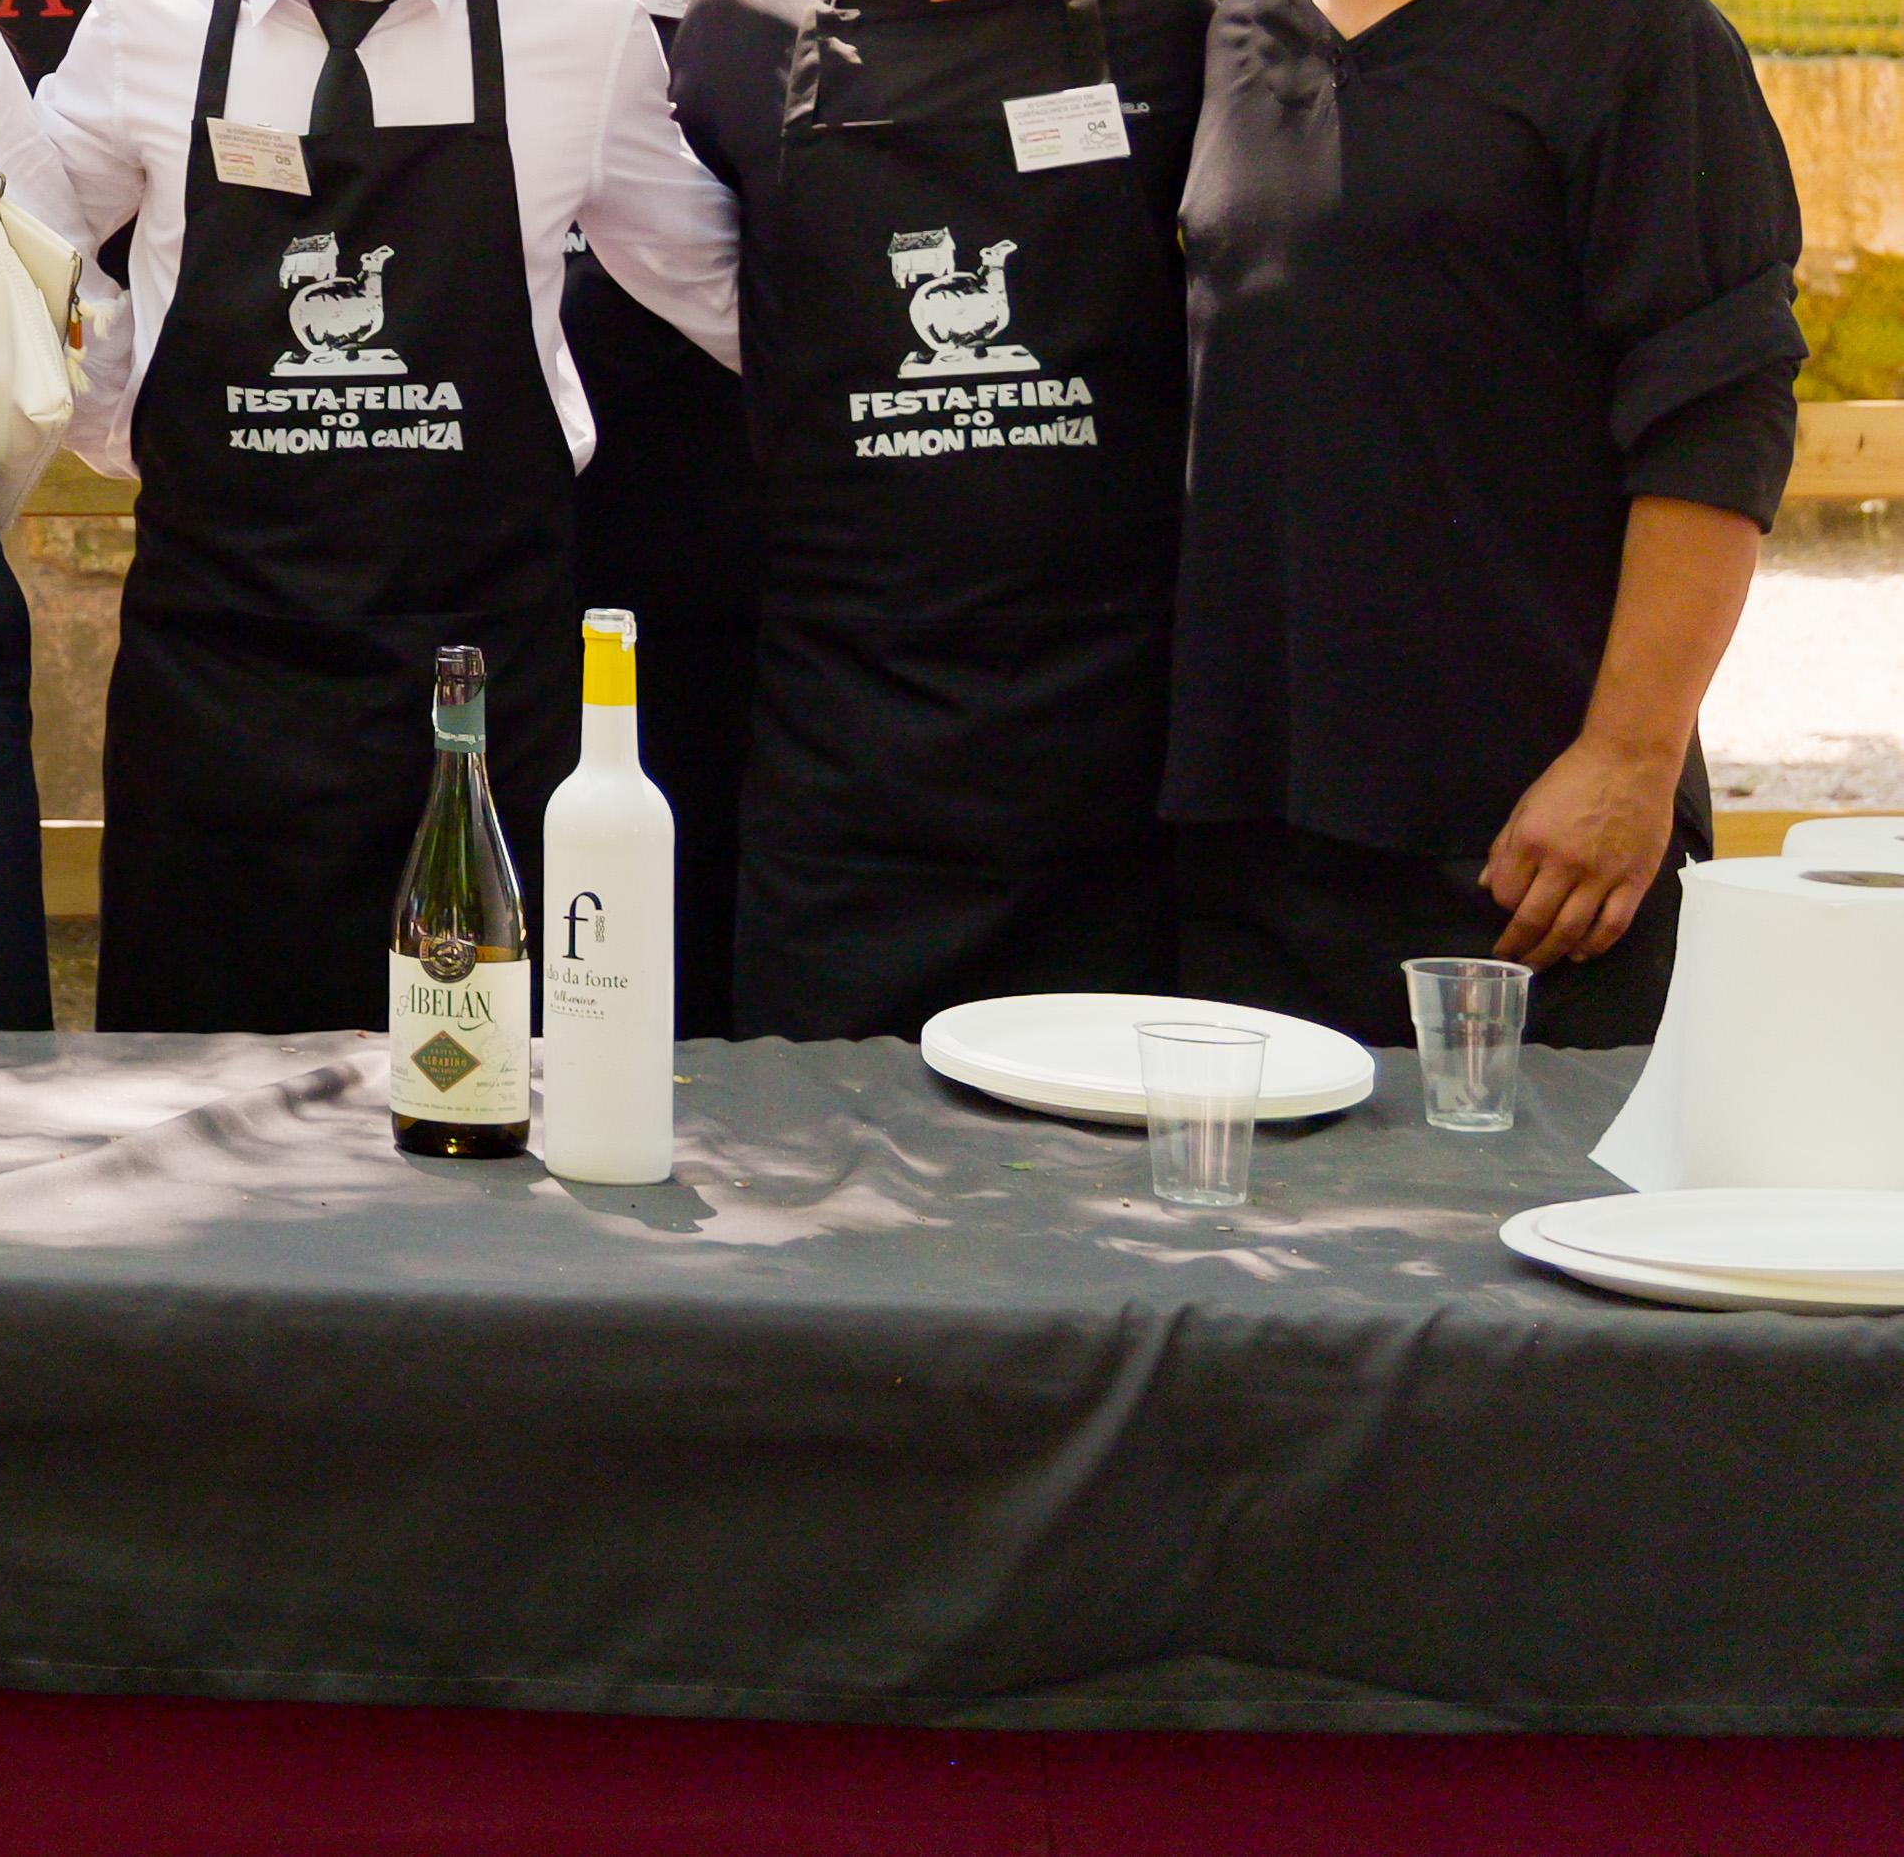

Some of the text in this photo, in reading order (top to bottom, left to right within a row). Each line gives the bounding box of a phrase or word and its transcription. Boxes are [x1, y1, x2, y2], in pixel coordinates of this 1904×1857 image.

[226, 381, 464, 413] FESTA-FEIRA
[848, 376, 1093, 422] FESTA-FEIRA
[320, 412, 360, 428] DO
[953, 410, 995, 427] DO
[335, 429, 369, 448] NA
[971, 428, 1006, 447] NA
[561, 891, 603, 961] f
[562, 967, 580, 985] da
[396, 982, 497, 1031] ABELÁN
